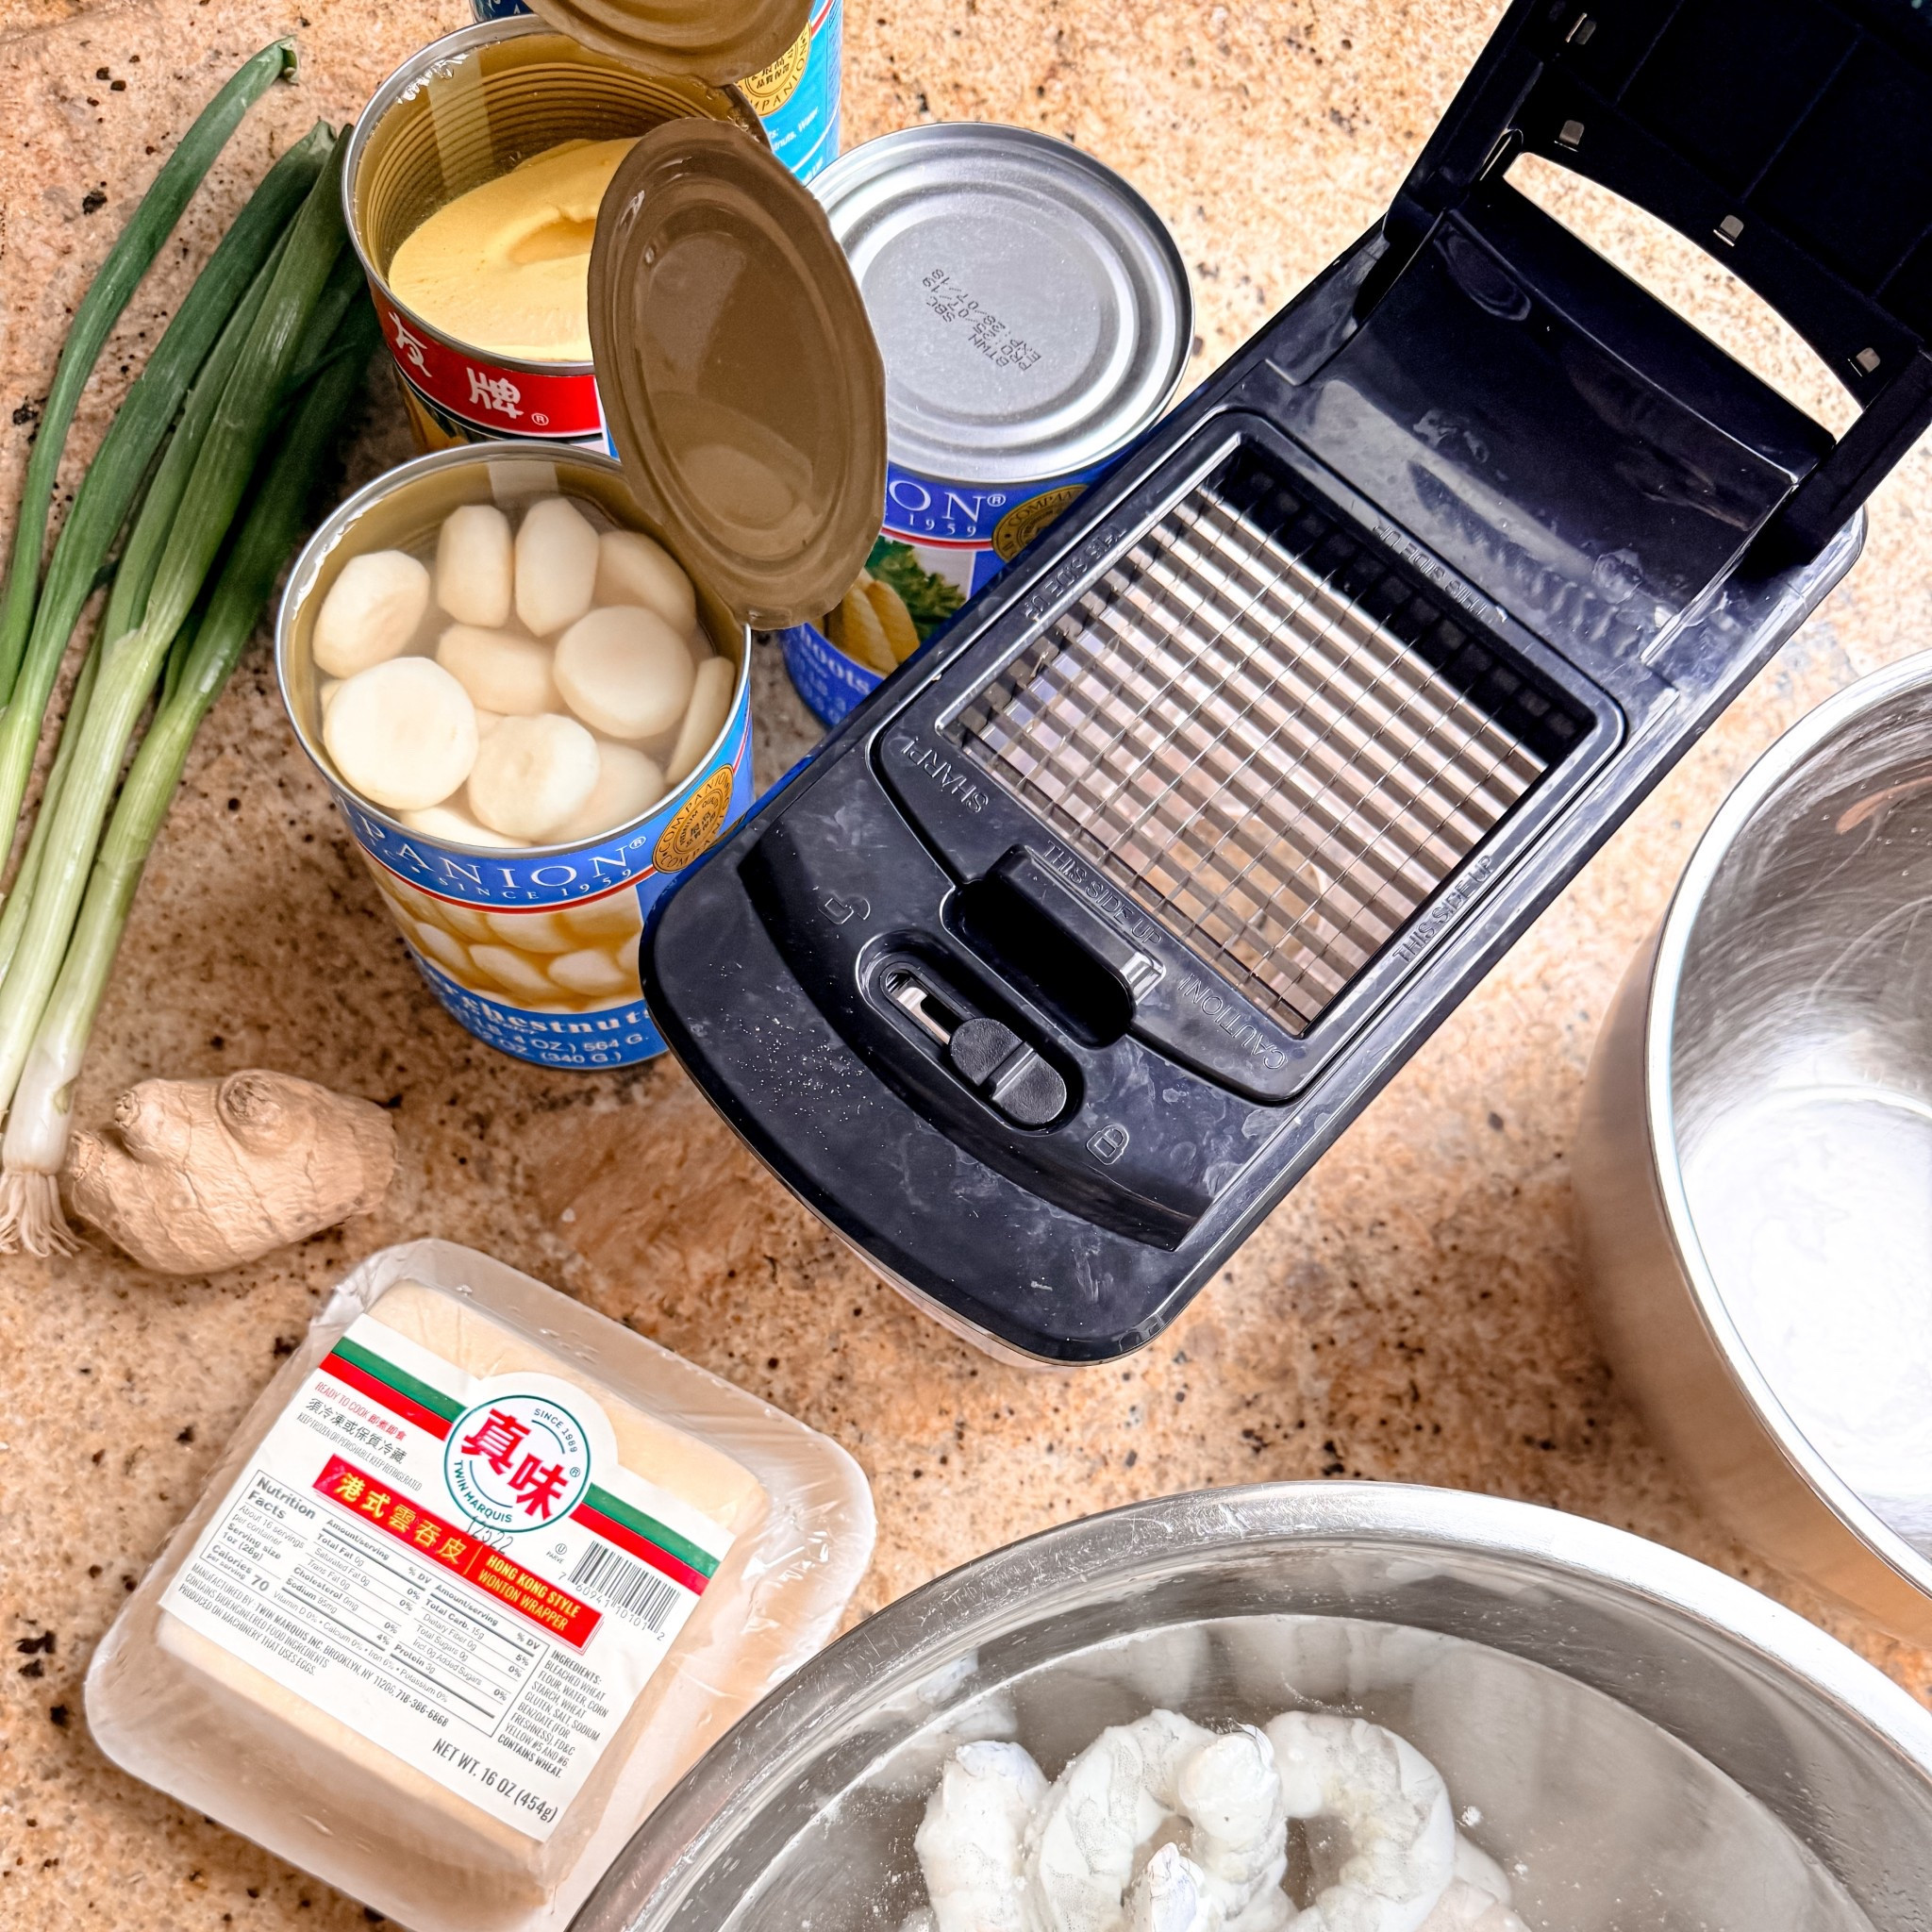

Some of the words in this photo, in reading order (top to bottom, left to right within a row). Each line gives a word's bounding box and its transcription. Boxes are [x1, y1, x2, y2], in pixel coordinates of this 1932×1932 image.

[909, 513, 976, 537] 1959
[1044, 558, 1088, 597] SIDE
[1400, 542, 1445, 581] SIDE
[900, 736, 990, 813] SHARP!
[439, 876, 540, 900] SINCE
[560, 868, 633, 897] 1959
[1043, 840, 1088, 884] THIS
[1086, 881, 1132, 924] SIDE
[1131, 917, 1163, 945] UP
[1391, 922, 1435, 962] THIS
[1431, 879, 1475, 924] SIDE
[1468, 855, 1492, 883] UP
[1178, 973, 1289, 1071] CAUTION!
[583, 1040, 620, 1053] 564
[315, 1381, 341, 1401] READY
[338, 1394, 350, 1407] TO
[347, 1401, 370, 1419] COOK
[533, 1407, 564, 1430] SINCE
[561, 1427, 578, 1453] 1989
[461, 1408, 570, 1522] 真味
[247, 1490, 288, 1520] Facts
[256, 1476, 318, 1520] Nutrition
[454, 1459, 470, 1492] TWIN
[463, 1488, 513, 1524] MARQUIS
[239, 1504, 262, 1522] About
[261, 1518, 274, 1529] 16
[271, 1524, 306, 1550] servings
[332, 1470, 470, 1566] 港式雲吞皮
[221, 1531, 239, 1544] 1oz
[225, 1522, 262, 1549] Serving
[261, 1543, 282, 1559] size
[316, 1533, 339, 1550] Total
[338, 1546, 354, 1559] Fat
[210, 1543, 254, 1574] Calories
[347, 1567, 361, 1579] Fat
[249, 1574, 271, 1592] 70
[285, 1577, 318, 1601] Sodium
[292, 1566, 342, 1600] Cholesterol
[406, 1587, 422, 1600] 0%
[476, 1569, 522, 1602] WONTON
[518, 1593, 569, 1631] WRAPPER
[485, 1554, 519, 1581] HONG
[516, 1572, 549, 1599] KONG
[545, 1590, 581, 1618] STYLE
[398, 1598, 414, 1611] 0%
[424, 1598, 447, 1616] Total
[446, 1612, 471, 1630] Carb.
[575, 1582, 610, 1608] 60941
[613, 1606, 648, 1631] 10101
[254, 1602, 275, 1620] TWIN
[273, 1613, 310, 1641] MARQUIS
[360, 1667, 374, 1680] NY
[375, 1632, 391, 1645] 4%
[383, 1621, 399, 1634] 0%
[259, 1634, 280, 1652] THAT
[276, 1645, 299, 1663] USES
[393, 1643, 425, 1667] Protein
[514, 1653, 530, 1666] 5%
[508, 1664, 523, 1677] 0%
[543, 1659, 581, 1688] BLEACHED
[578, 1680, 606, 1702] WHEAT
[550, 1649, 603, 1686] INGREDIENTS:
[492, 1688, 508, 1701] 0%
[529, 1680, 562, 1705] STARCH,
[559, 1698, 586, 1719] WHEAT
[537, 1670, 564, 1691] FLOUR,
[560, 1684, 590, 1707] WATER,
[586, 1699, 608, 1718] CORN
[517, 1701, 554, 1728] BENZOATE
[524, 1690, 555, 1715] GLUTEN,
[552, 1707, 574, 1726] SALT,
[570, 1718, 600, 1742] SODIUM
[496, 1733, 536, 1762] CONTAINS
[534, 1756, 563, 1778] WHEAT.
[503, 1723, 534, 1746] YELLOW
[541, 1745, 558, 1761] AND
[553, 1738, 575, 1756] FD&C
[432, 1737, 459, 1762] NET
[456, 1752, 483, 1776] WT.
[478, 1766, 499, 1786] 16
[495, 1776, 517, 1798] OZ
[512, 1786, 558, 1825] (454g)
